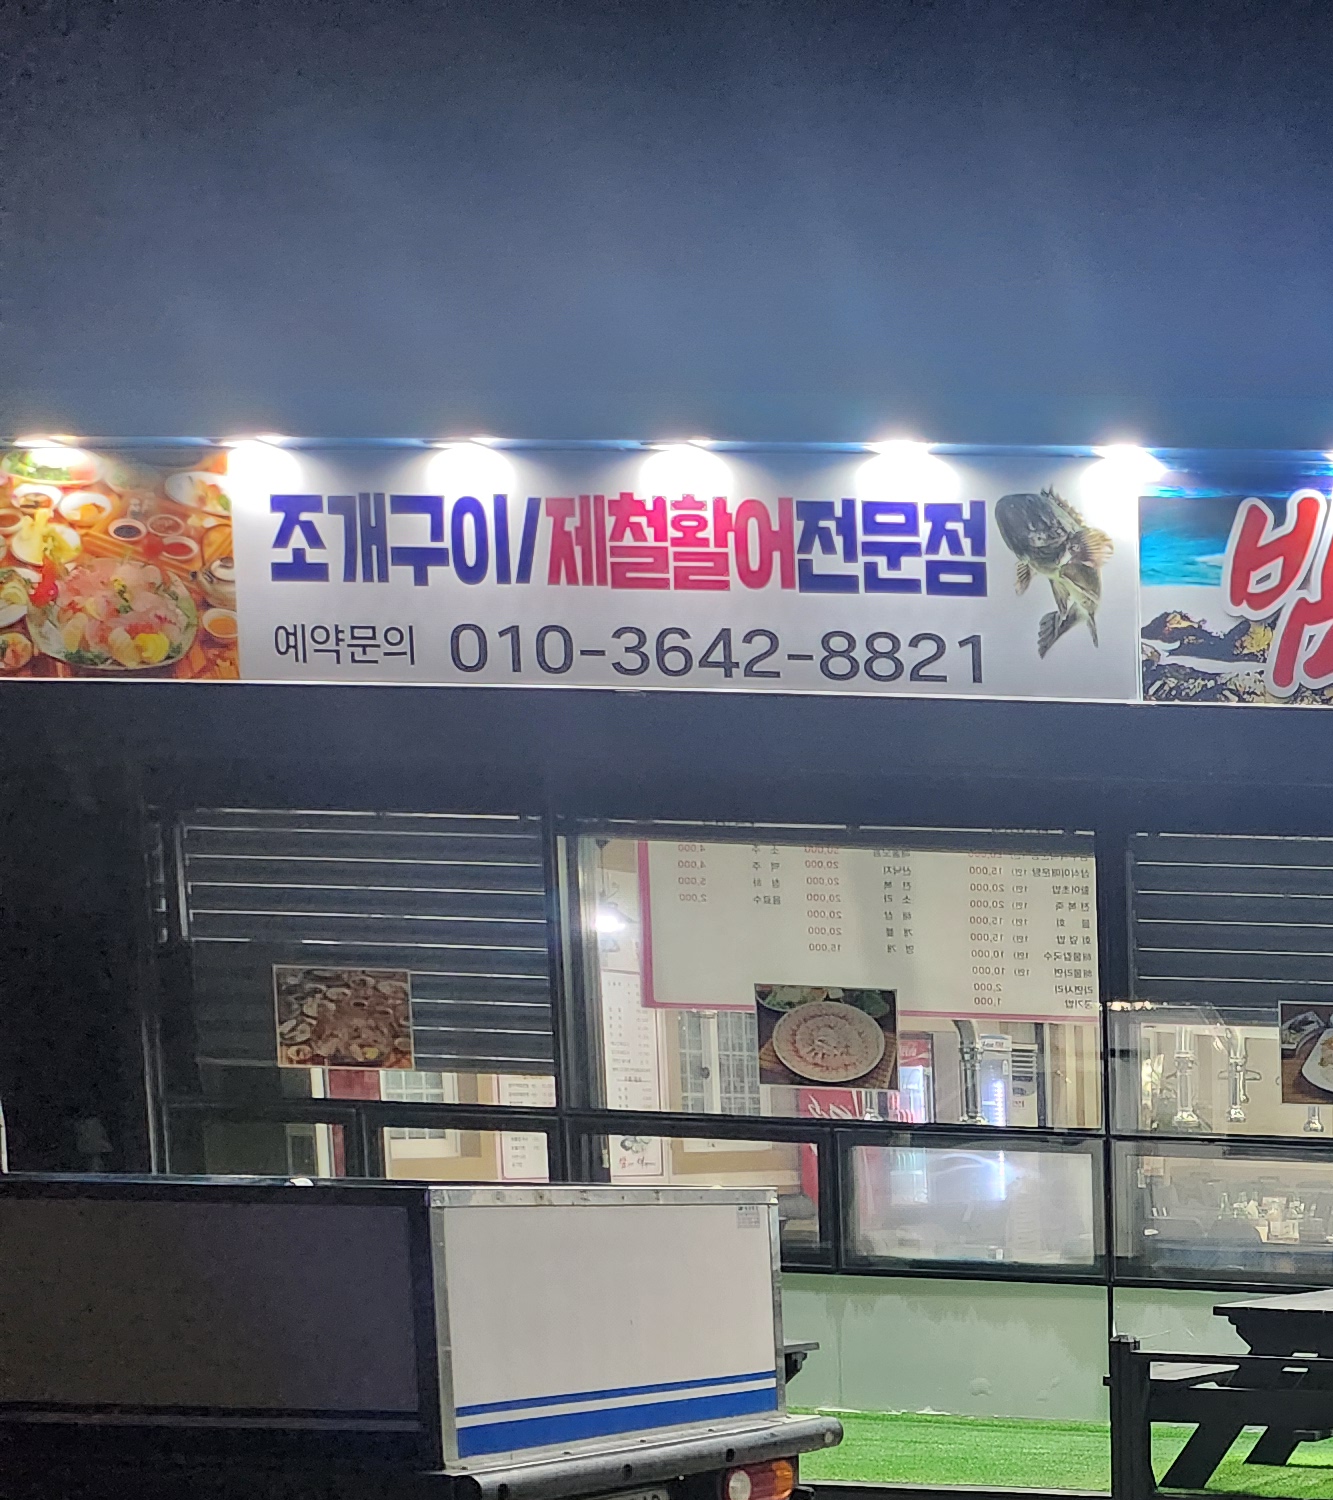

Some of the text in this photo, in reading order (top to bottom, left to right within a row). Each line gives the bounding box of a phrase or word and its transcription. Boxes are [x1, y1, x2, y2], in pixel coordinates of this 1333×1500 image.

[270, 492, 989, 597] 조개구이/제철활어전문점
[273, 622, 985, 685] 예약문의 010-3642-8821
